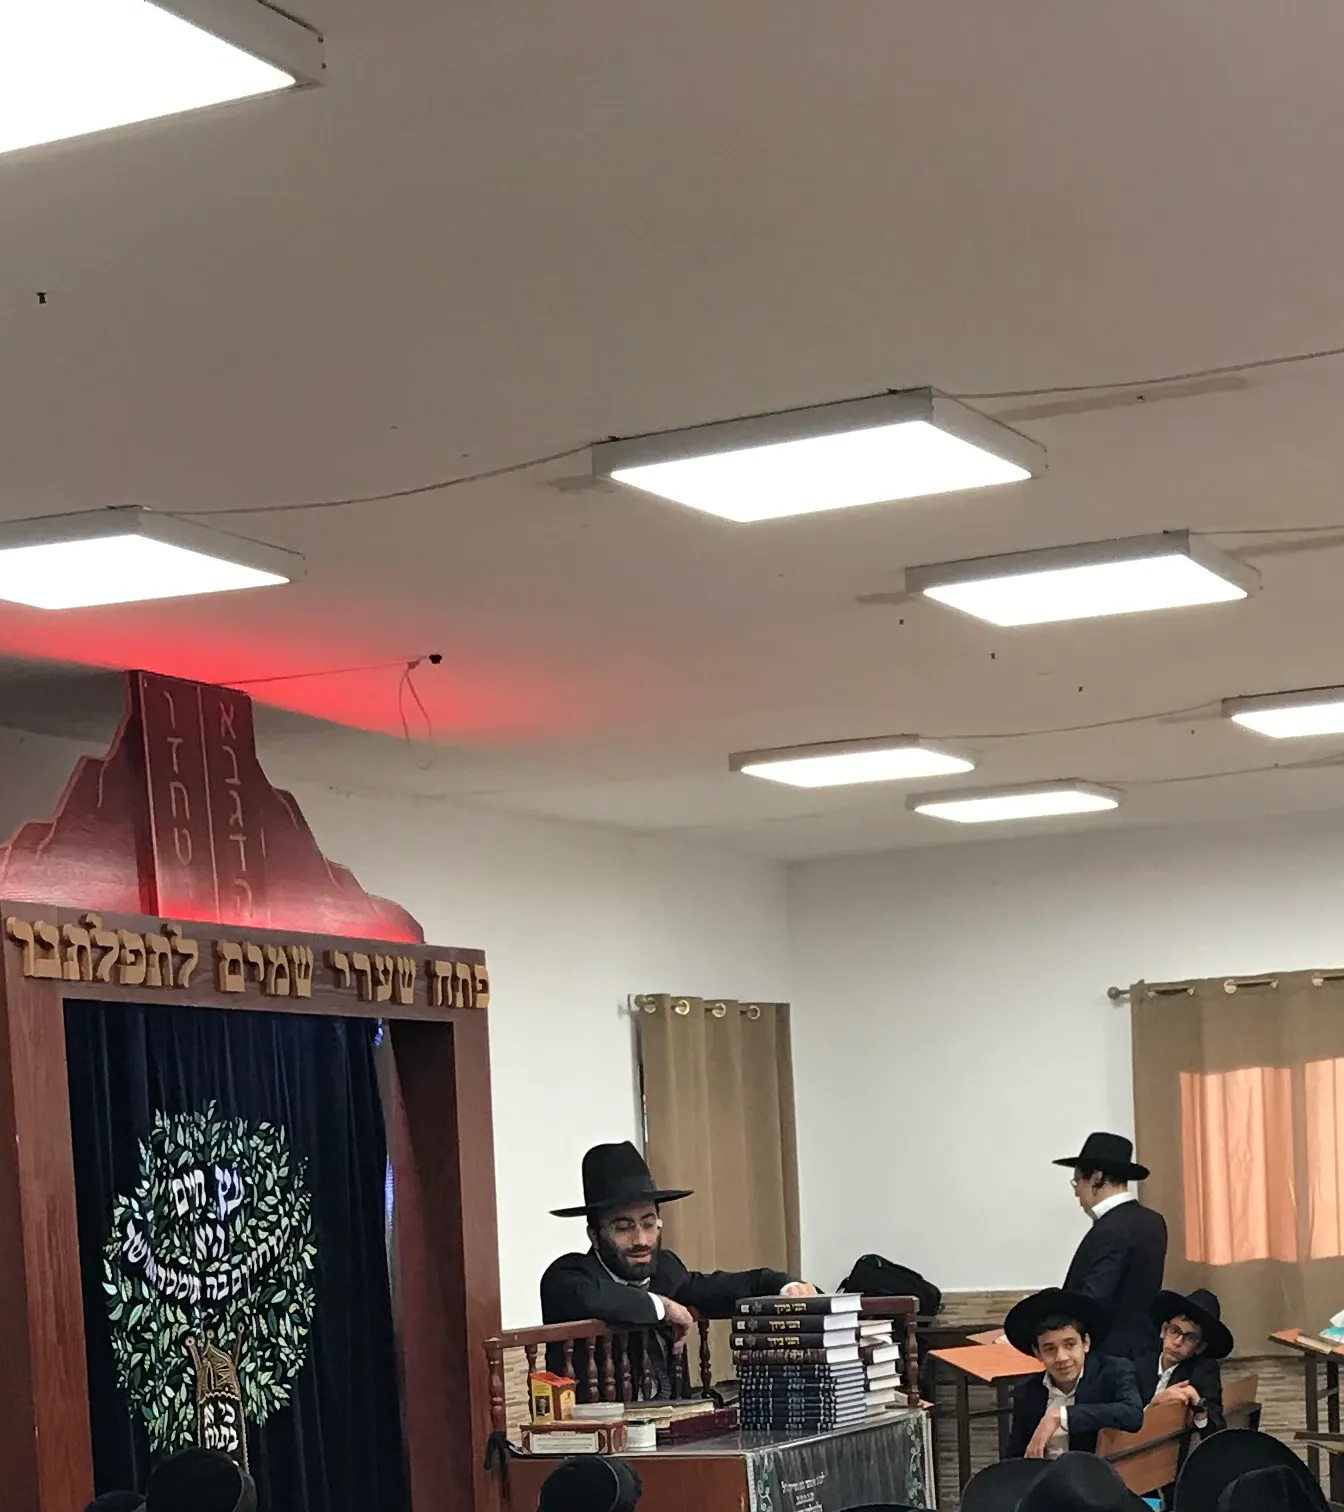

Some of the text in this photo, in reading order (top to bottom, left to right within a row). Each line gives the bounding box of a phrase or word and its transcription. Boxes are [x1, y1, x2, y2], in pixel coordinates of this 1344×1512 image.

[214, 939, 314, 998] שמים
[331, 949, 417, 1004] שערי
[433, 959, 490, 1009] פתח
[172, 1163, 246, 1222] עץ חיים
[206, 1273, 230, 1301] בה
